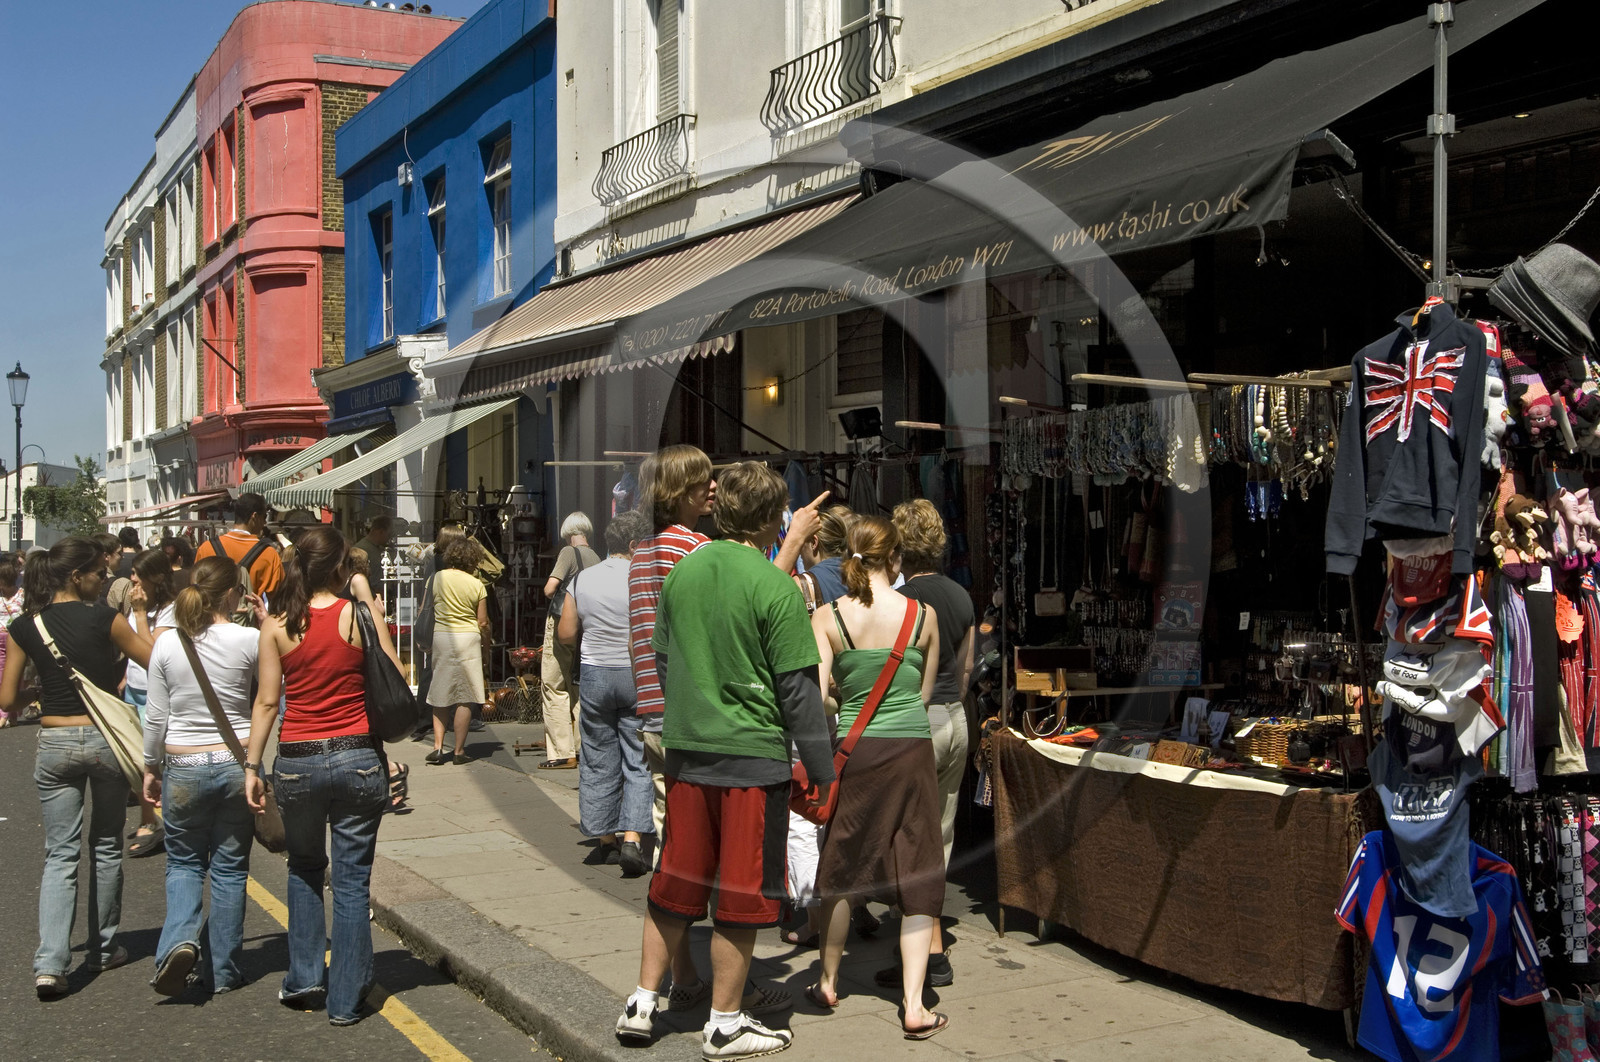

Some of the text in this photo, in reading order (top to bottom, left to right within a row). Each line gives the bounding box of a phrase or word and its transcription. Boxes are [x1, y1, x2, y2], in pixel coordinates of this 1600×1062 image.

[1052, 183, 1251, 252] www.tashi.co.uk
[671, 316, 700, 341] 7221
[749, 296, 783, 320] 82A
[783, 279, 857, 314] Portobello
[859, 267, 901, 297] Road,
[904, 255, 965, 289] London
[971, 239, 1014, 270] W11
[351, 378, 402, 410] CHLOE ALBERRY
[1401, 670, 1418, 680] Food
[1401, 714, 1437, 740] LONDON
[1386, 914, 1470, 1013] 12
